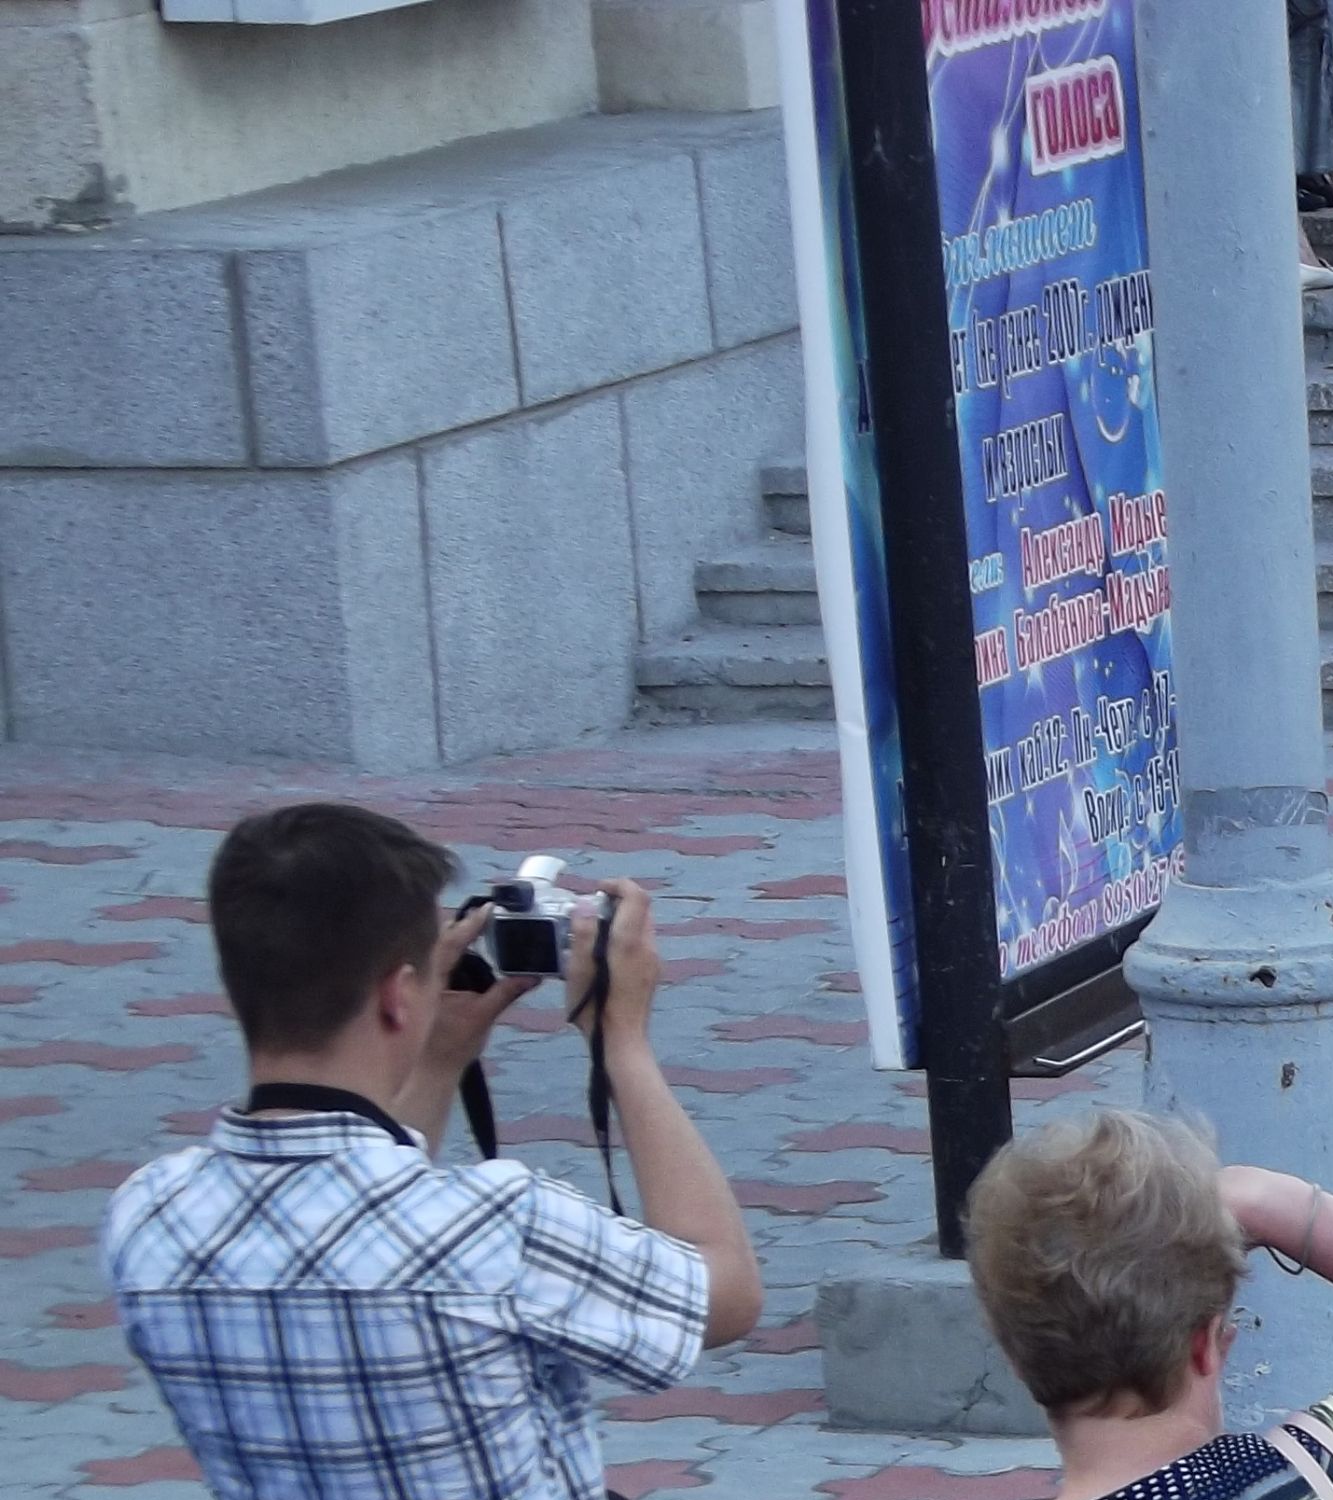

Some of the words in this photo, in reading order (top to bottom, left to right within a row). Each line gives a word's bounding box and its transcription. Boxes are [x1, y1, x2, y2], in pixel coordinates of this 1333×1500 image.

[1028, 65, 1123, 164] голоса
[950, 328, 970, 395] ет
[973, 309, 997, 389] (не
[1000, 304, 1042, 399] ранее
[983, 437, 997, 503] и
[998, 413, 1069, 511] взрослых
[1021, 512, 1105, 590] Александр
[1109, 489, 1168, 557] Мадые
[1014, 565, 1171, 671] Балабанова-Мадыев
[985, 747, 1015, 806] мик
[1141, 688, 1152, 738] с
[1153, 670, 1177, 730] 17-
[1083, 785, 1131, 846] Воскр.
[1134, 774, 1145, 825] с
[1015, 901, 1099, 970] телефону
